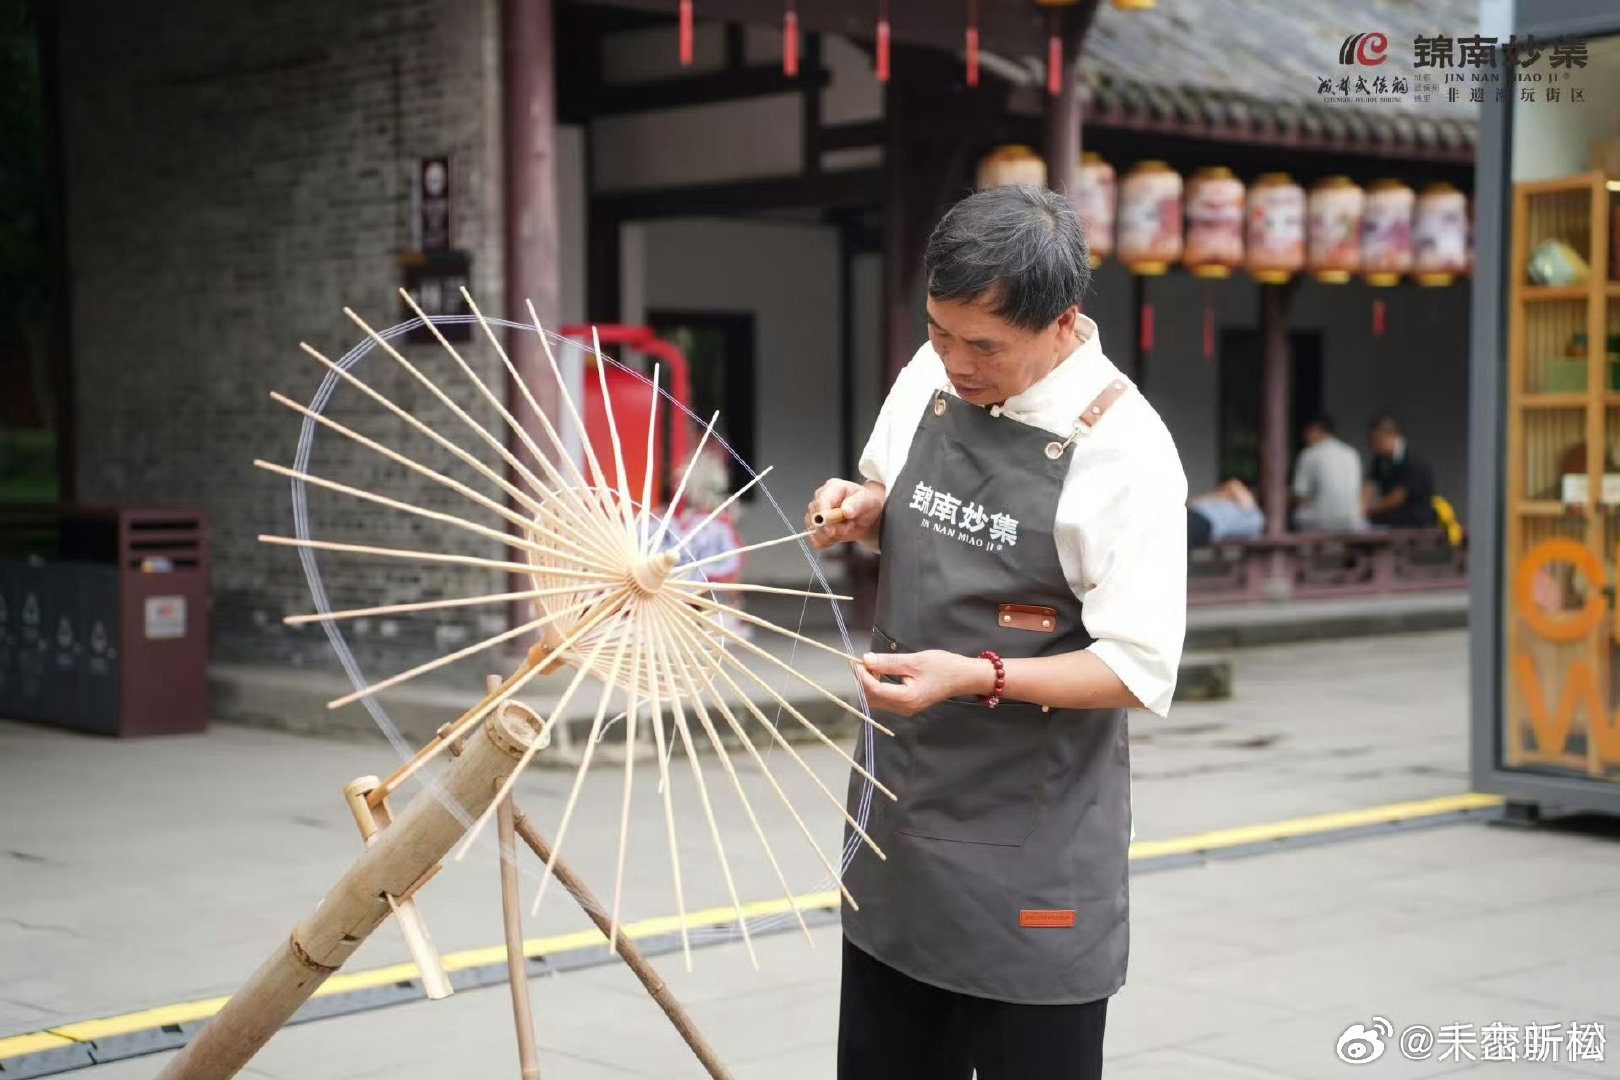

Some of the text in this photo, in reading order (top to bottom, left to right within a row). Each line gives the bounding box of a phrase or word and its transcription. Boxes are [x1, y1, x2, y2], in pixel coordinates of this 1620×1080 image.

[909, 480, 1019, 546] 锦南妙集
[932, 523, 956, 538] NAN
[957, 532, 983, 547] MIAO
